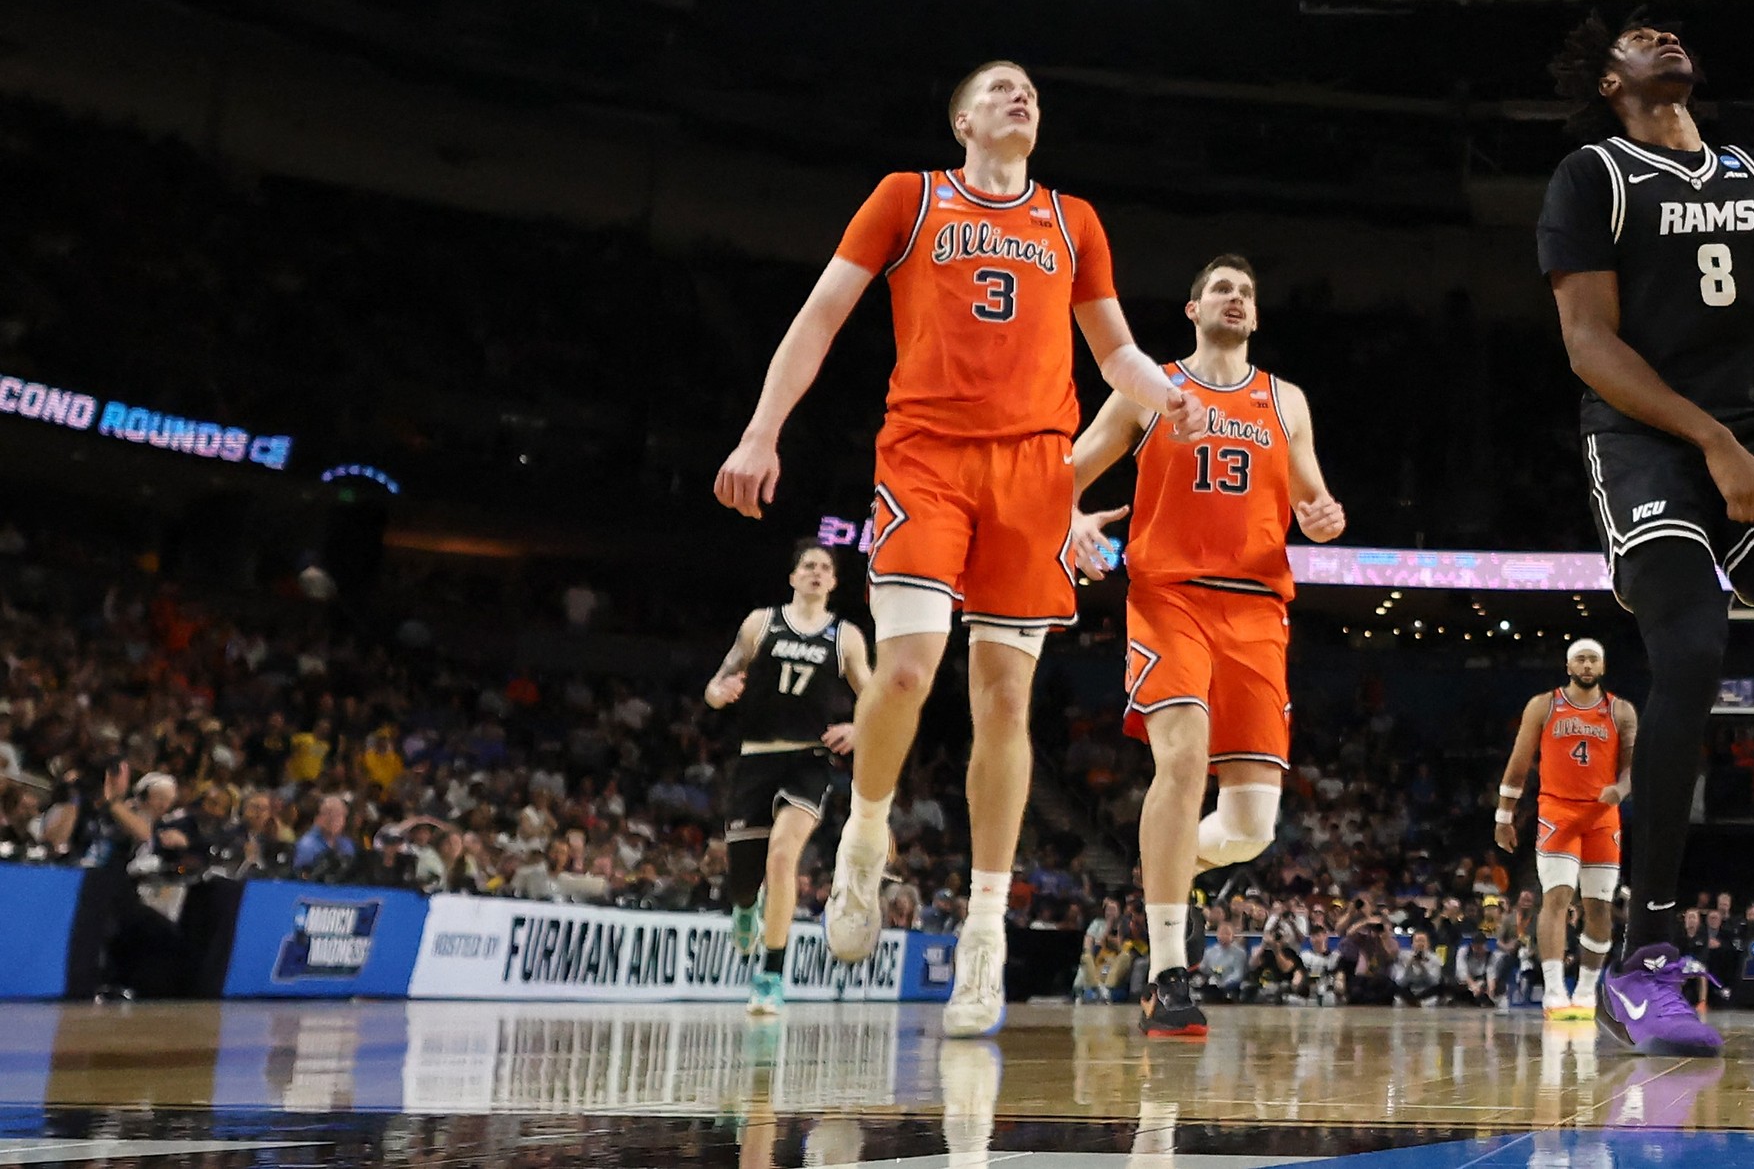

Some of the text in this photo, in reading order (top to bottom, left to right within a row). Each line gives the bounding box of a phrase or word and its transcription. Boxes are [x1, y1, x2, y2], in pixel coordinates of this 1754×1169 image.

[931, 221, 1058, 275] Illinois
[1696, 242, 1737, 307] 8
[971, 267, 1018, 323] 3
[99, 400, 250, 464] ROUNDS
[1174, 406, 1274, 450] linois
[1192, 444, 1252, 496] 13
[1630, 499, 1668, 524] VCU
[777, 660, 817, 697] 17
[1569, 739, 1591, 767] 4
[502, 916, 625, 986] FURMAN
[625, 926, 678, 986] AND
